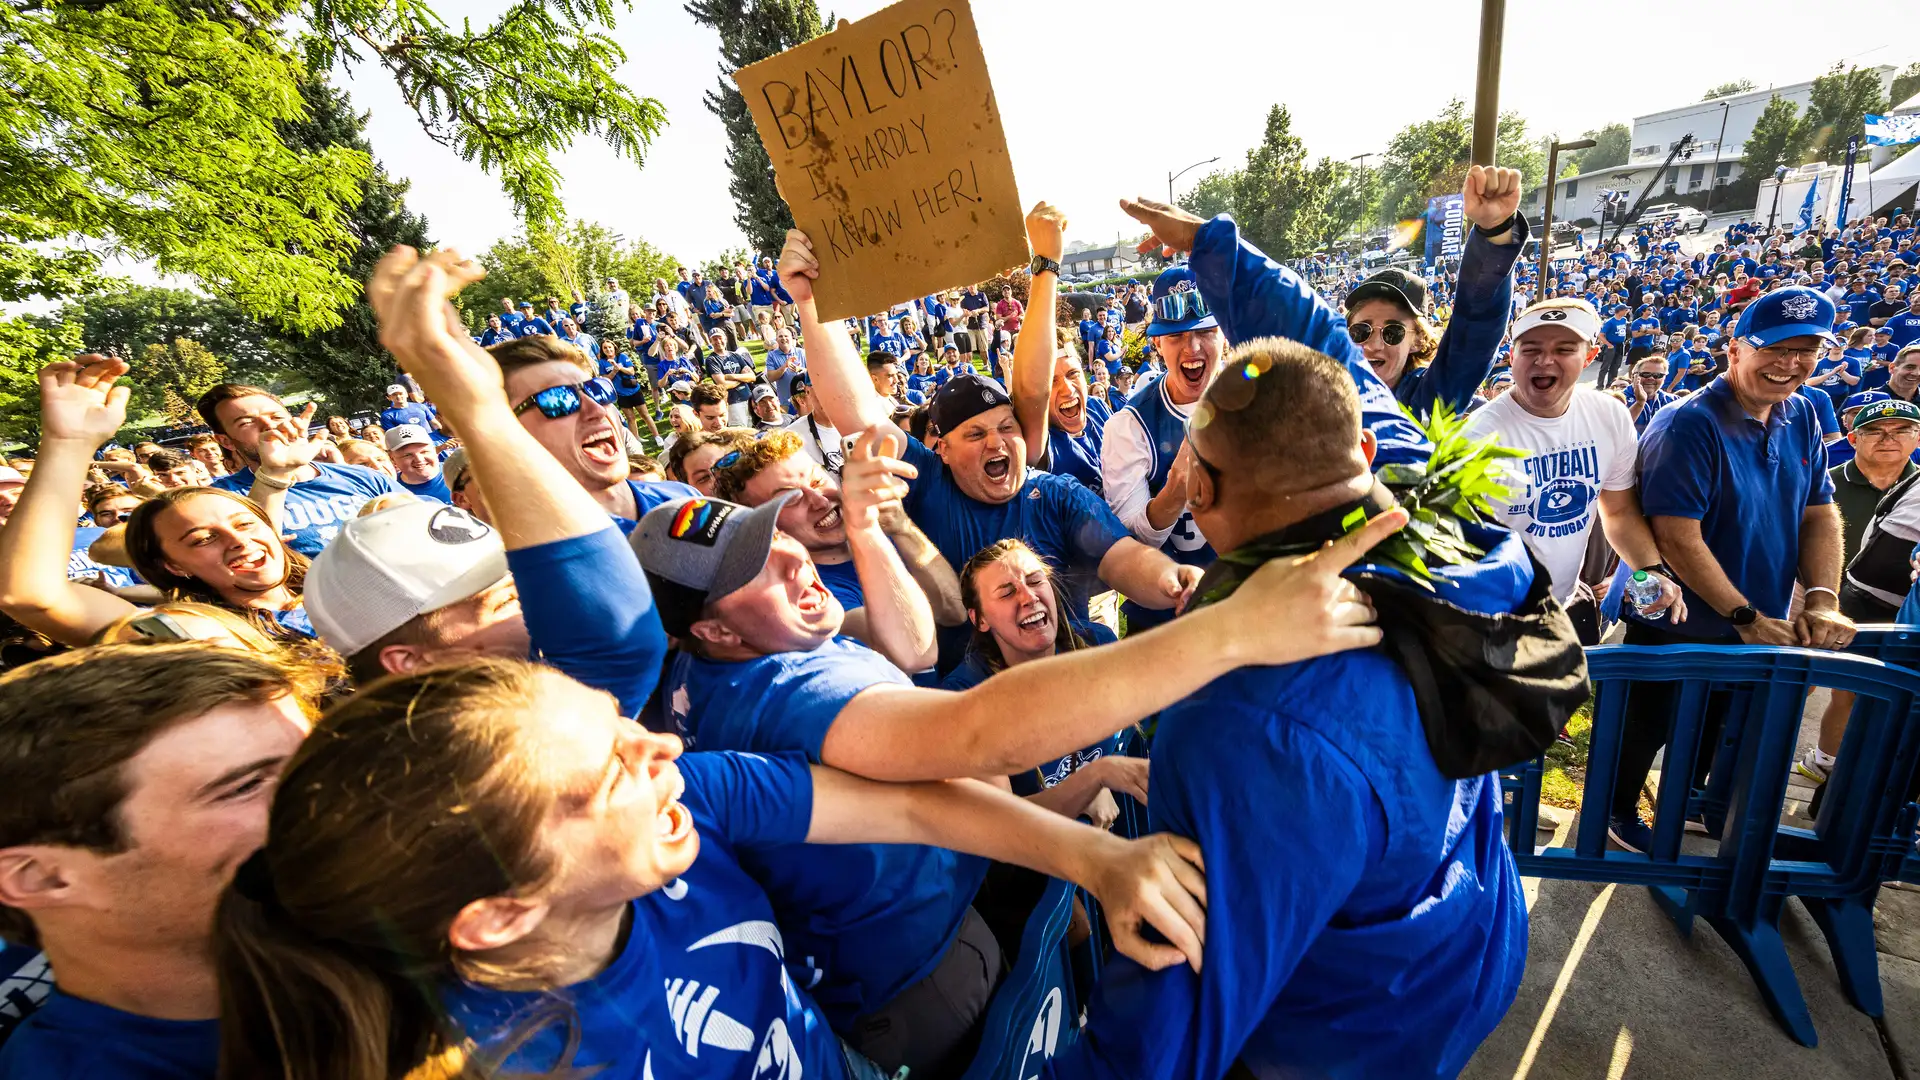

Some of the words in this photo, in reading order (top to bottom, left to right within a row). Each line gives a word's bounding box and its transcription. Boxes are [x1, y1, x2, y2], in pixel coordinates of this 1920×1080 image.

[762, 9, 959, 150] BAYLOR?
[800, 162, 830, 201] I
[844, 114, 931, 178] HARDLY
[821, 200, 902, 263] KNOW
[912, 160, 983, 224] HER!
[1441, 199, 1464, 255] COUGAR
[1524, 446, 1600, 498] FOOTBALL
[1525, 522, 1546, 537] BYU
